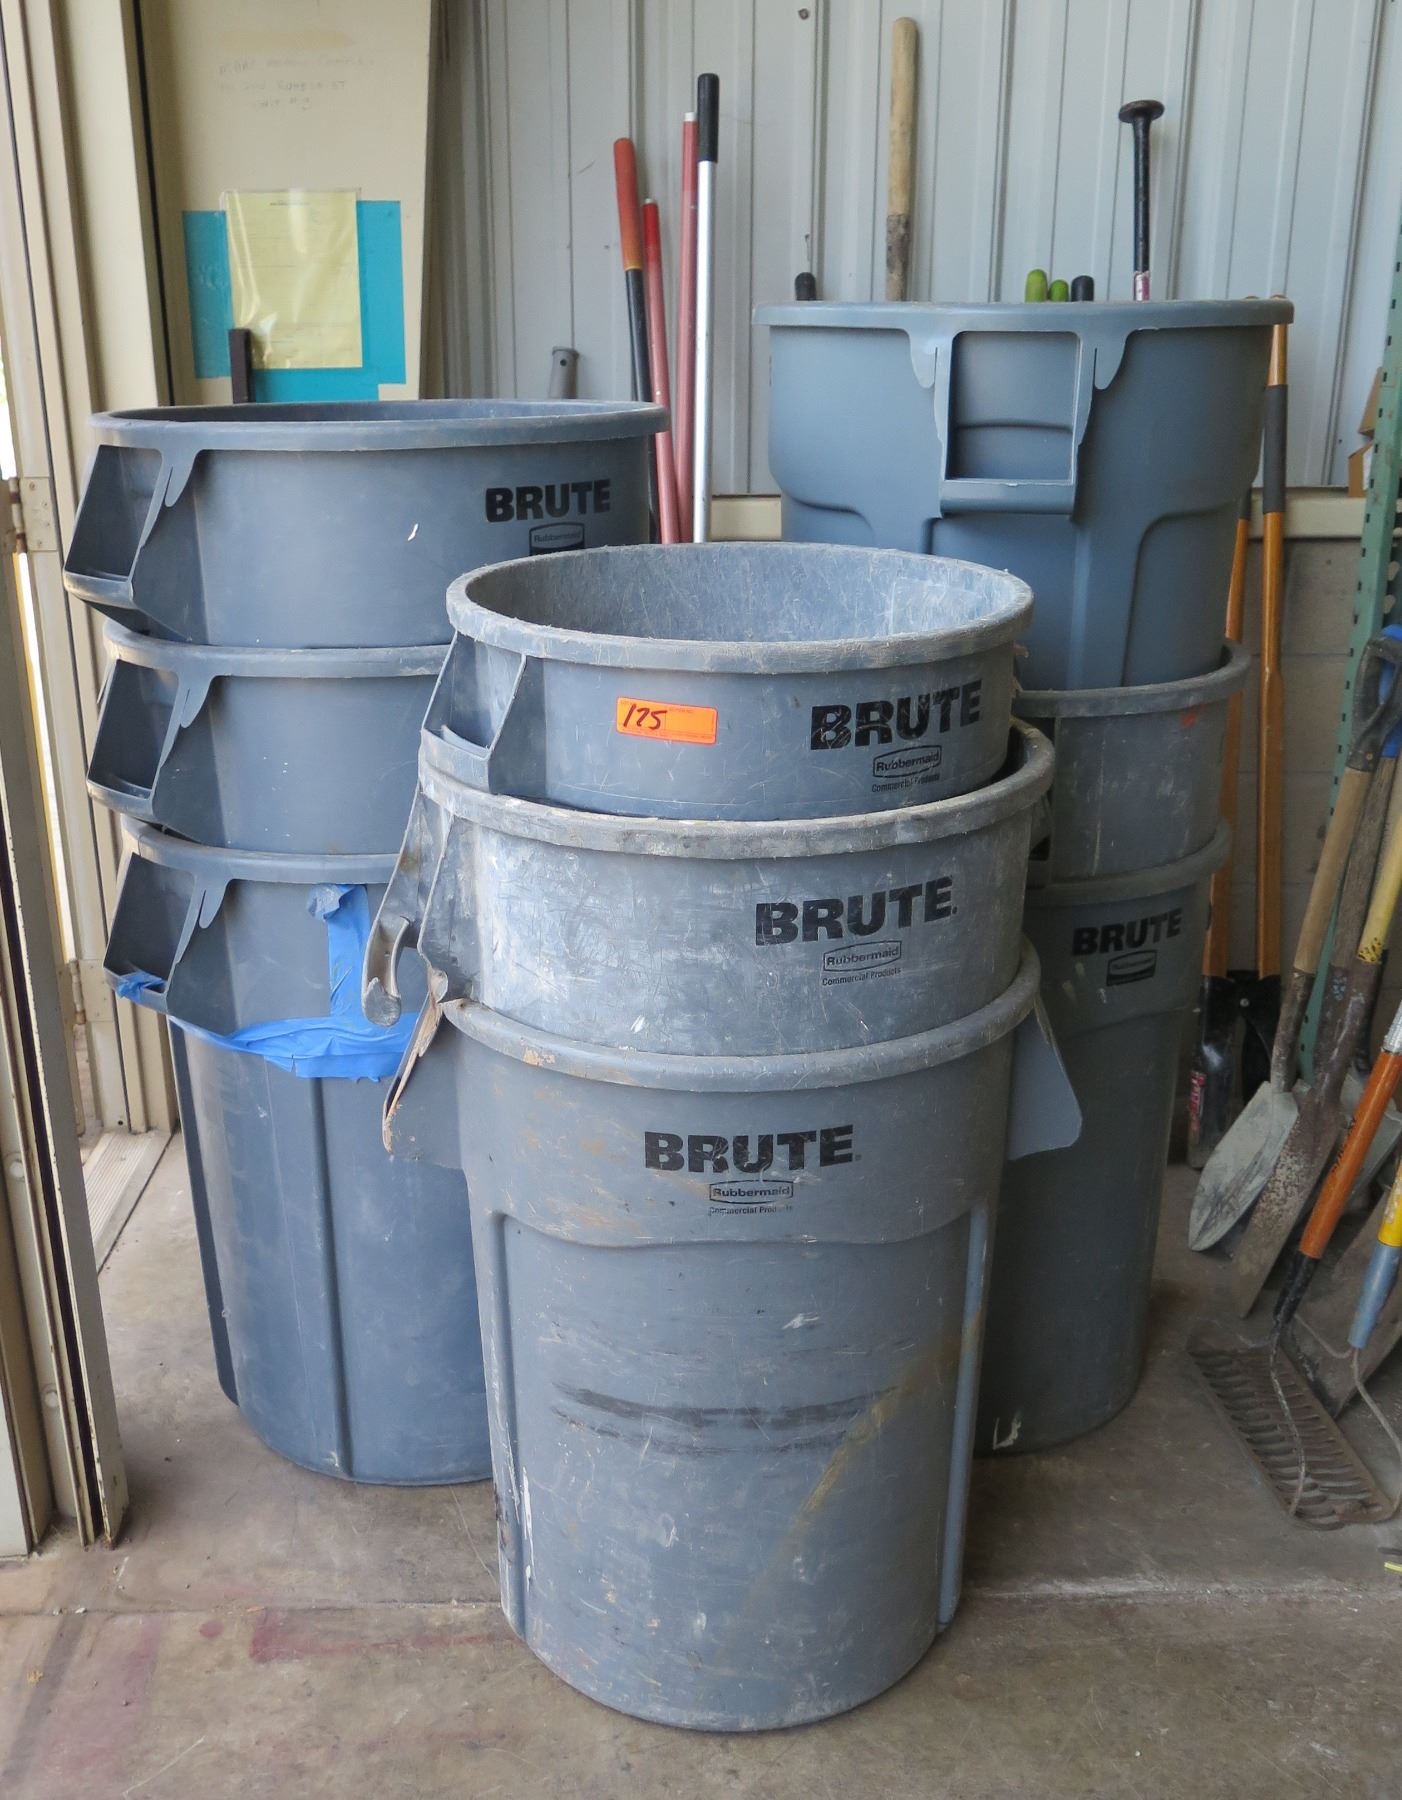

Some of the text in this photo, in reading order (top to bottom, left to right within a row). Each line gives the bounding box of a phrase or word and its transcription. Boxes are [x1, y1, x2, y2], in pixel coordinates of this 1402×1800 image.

[485, 479, 611, 523] BRUTE
[811, 680, 982, 750] BRUTE
[875, 750, 940, 772] Rubbermaid
[755, 876, 953, 946] BRUTE
[1072, 907, 1184, 956] BRUTE
[826, 946, 899, 966] Rubbermaid
[822, 972, 869, 986] Commercial
[644, 1124, 854, 1174] BRUTE
[713, 1184, 792, 1198] Rubbermaid
